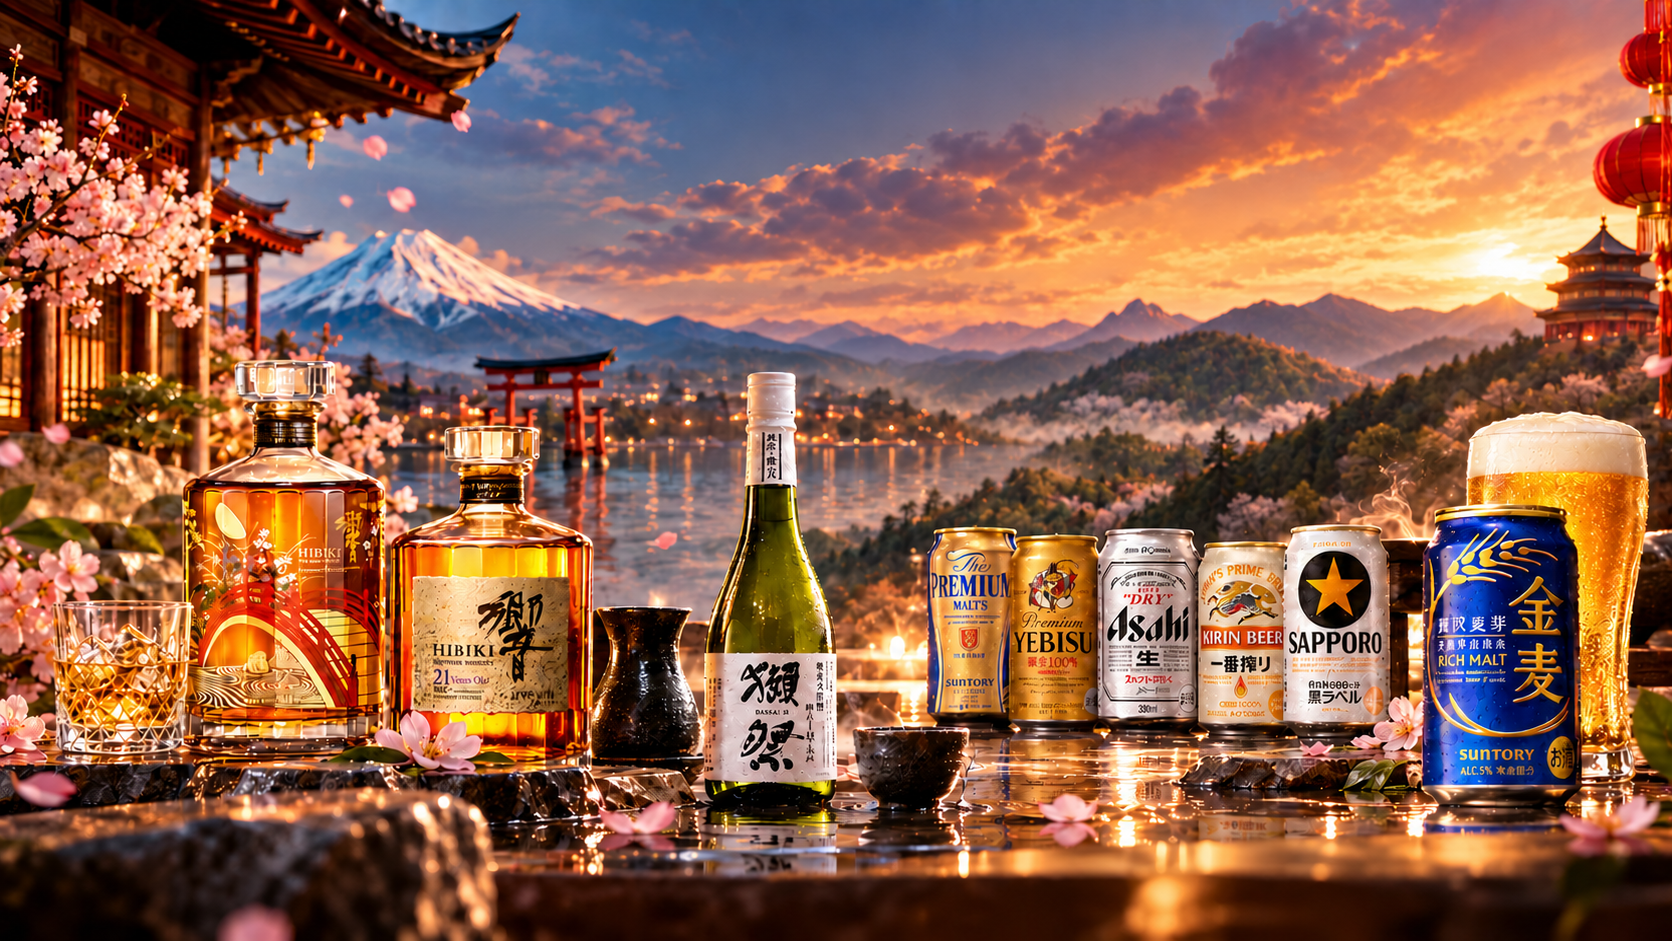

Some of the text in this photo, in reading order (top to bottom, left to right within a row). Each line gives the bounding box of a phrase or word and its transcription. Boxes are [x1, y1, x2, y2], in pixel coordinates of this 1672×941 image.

[298, 547, 342, 558] HIBIKI
[946, 552, 991, 572] The
[1226, 564, 1264, 578] PRIME
[953, 600, 988, 611] MALTS
[1020, 611, 1084, 629] Premium
[1107, 604, 1189, 642] Asahi
[1013, 631, 1093, 654] YEBISU
[1203, 630, 1283, 645] KIRIN BEER
[1288, 631, 1382, 654] SAPPORO
[1508, 575, 1564, 704] 金麦
[433, 643, 495, 657] HIBIKI
[1135, 649, 1160, 667] 生
[1438, 653, 1507, 667] RICH MALT
[433, 668, 450, 685] 21
[1308, 690, 1362, 704] 黒ラベル
